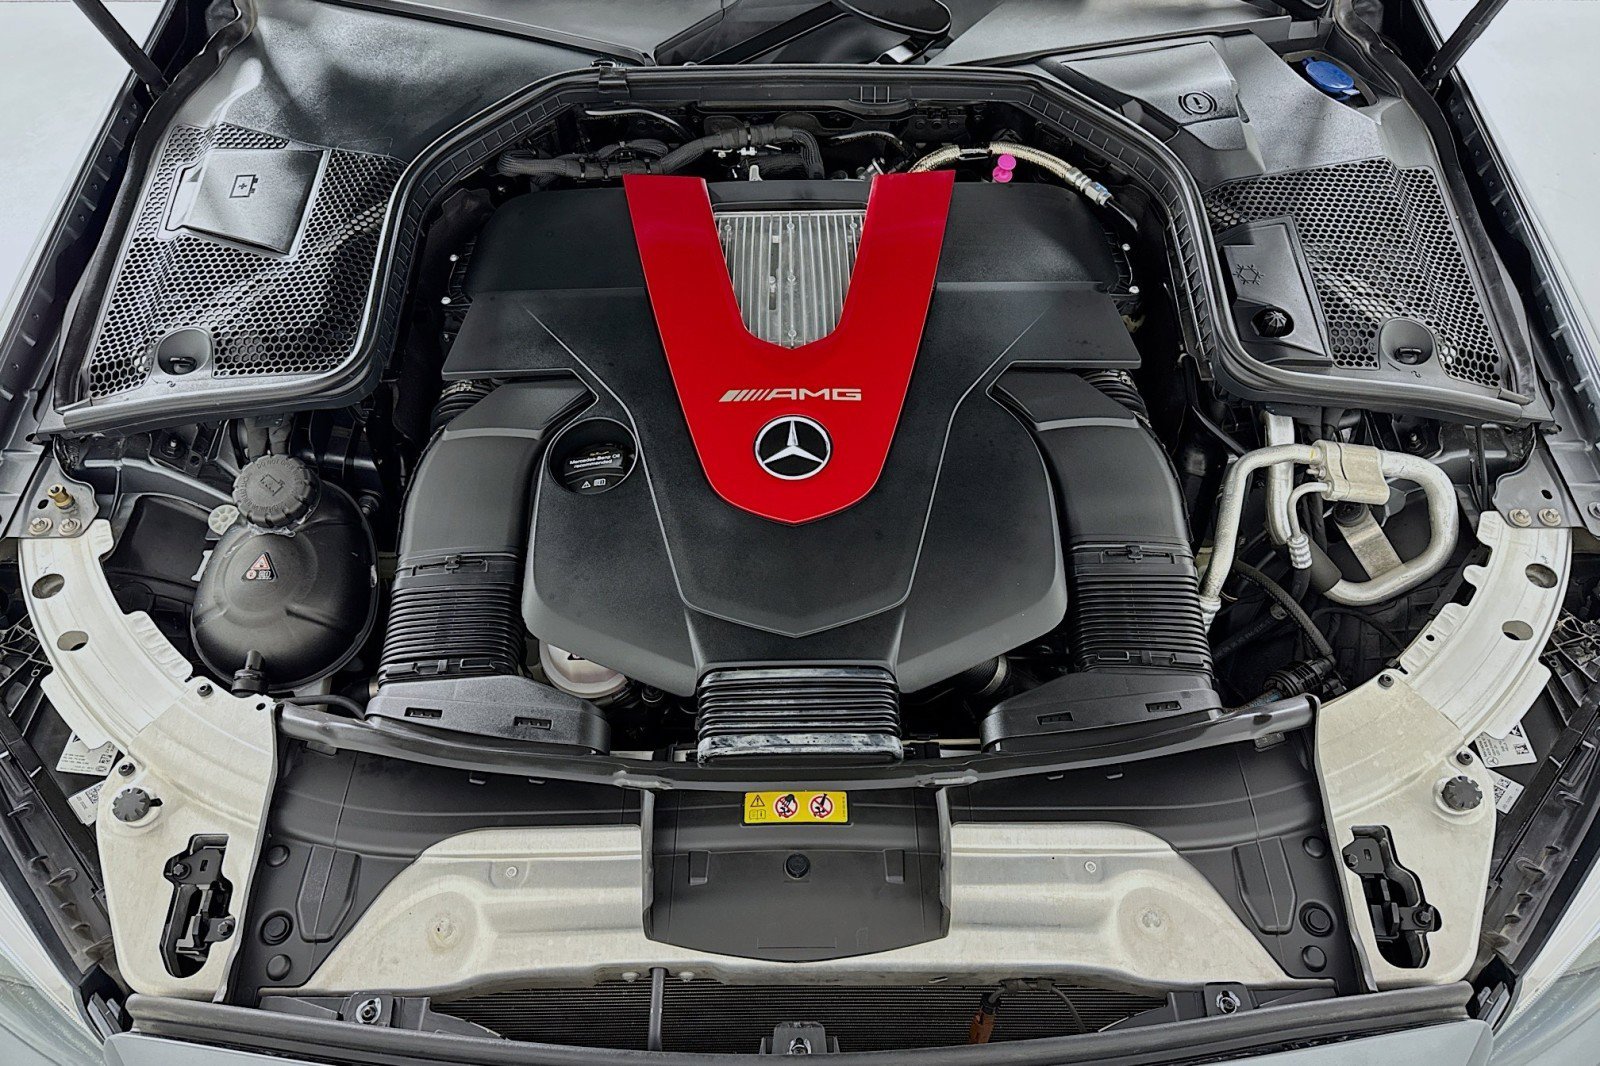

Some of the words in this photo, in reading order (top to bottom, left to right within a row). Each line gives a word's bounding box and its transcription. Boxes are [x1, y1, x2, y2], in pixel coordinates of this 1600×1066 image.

[764, 388, 862, 401] AMG
[570, 455, 611, 464] Mercedes-Benz
[574, 459, 612, 468] recommended
